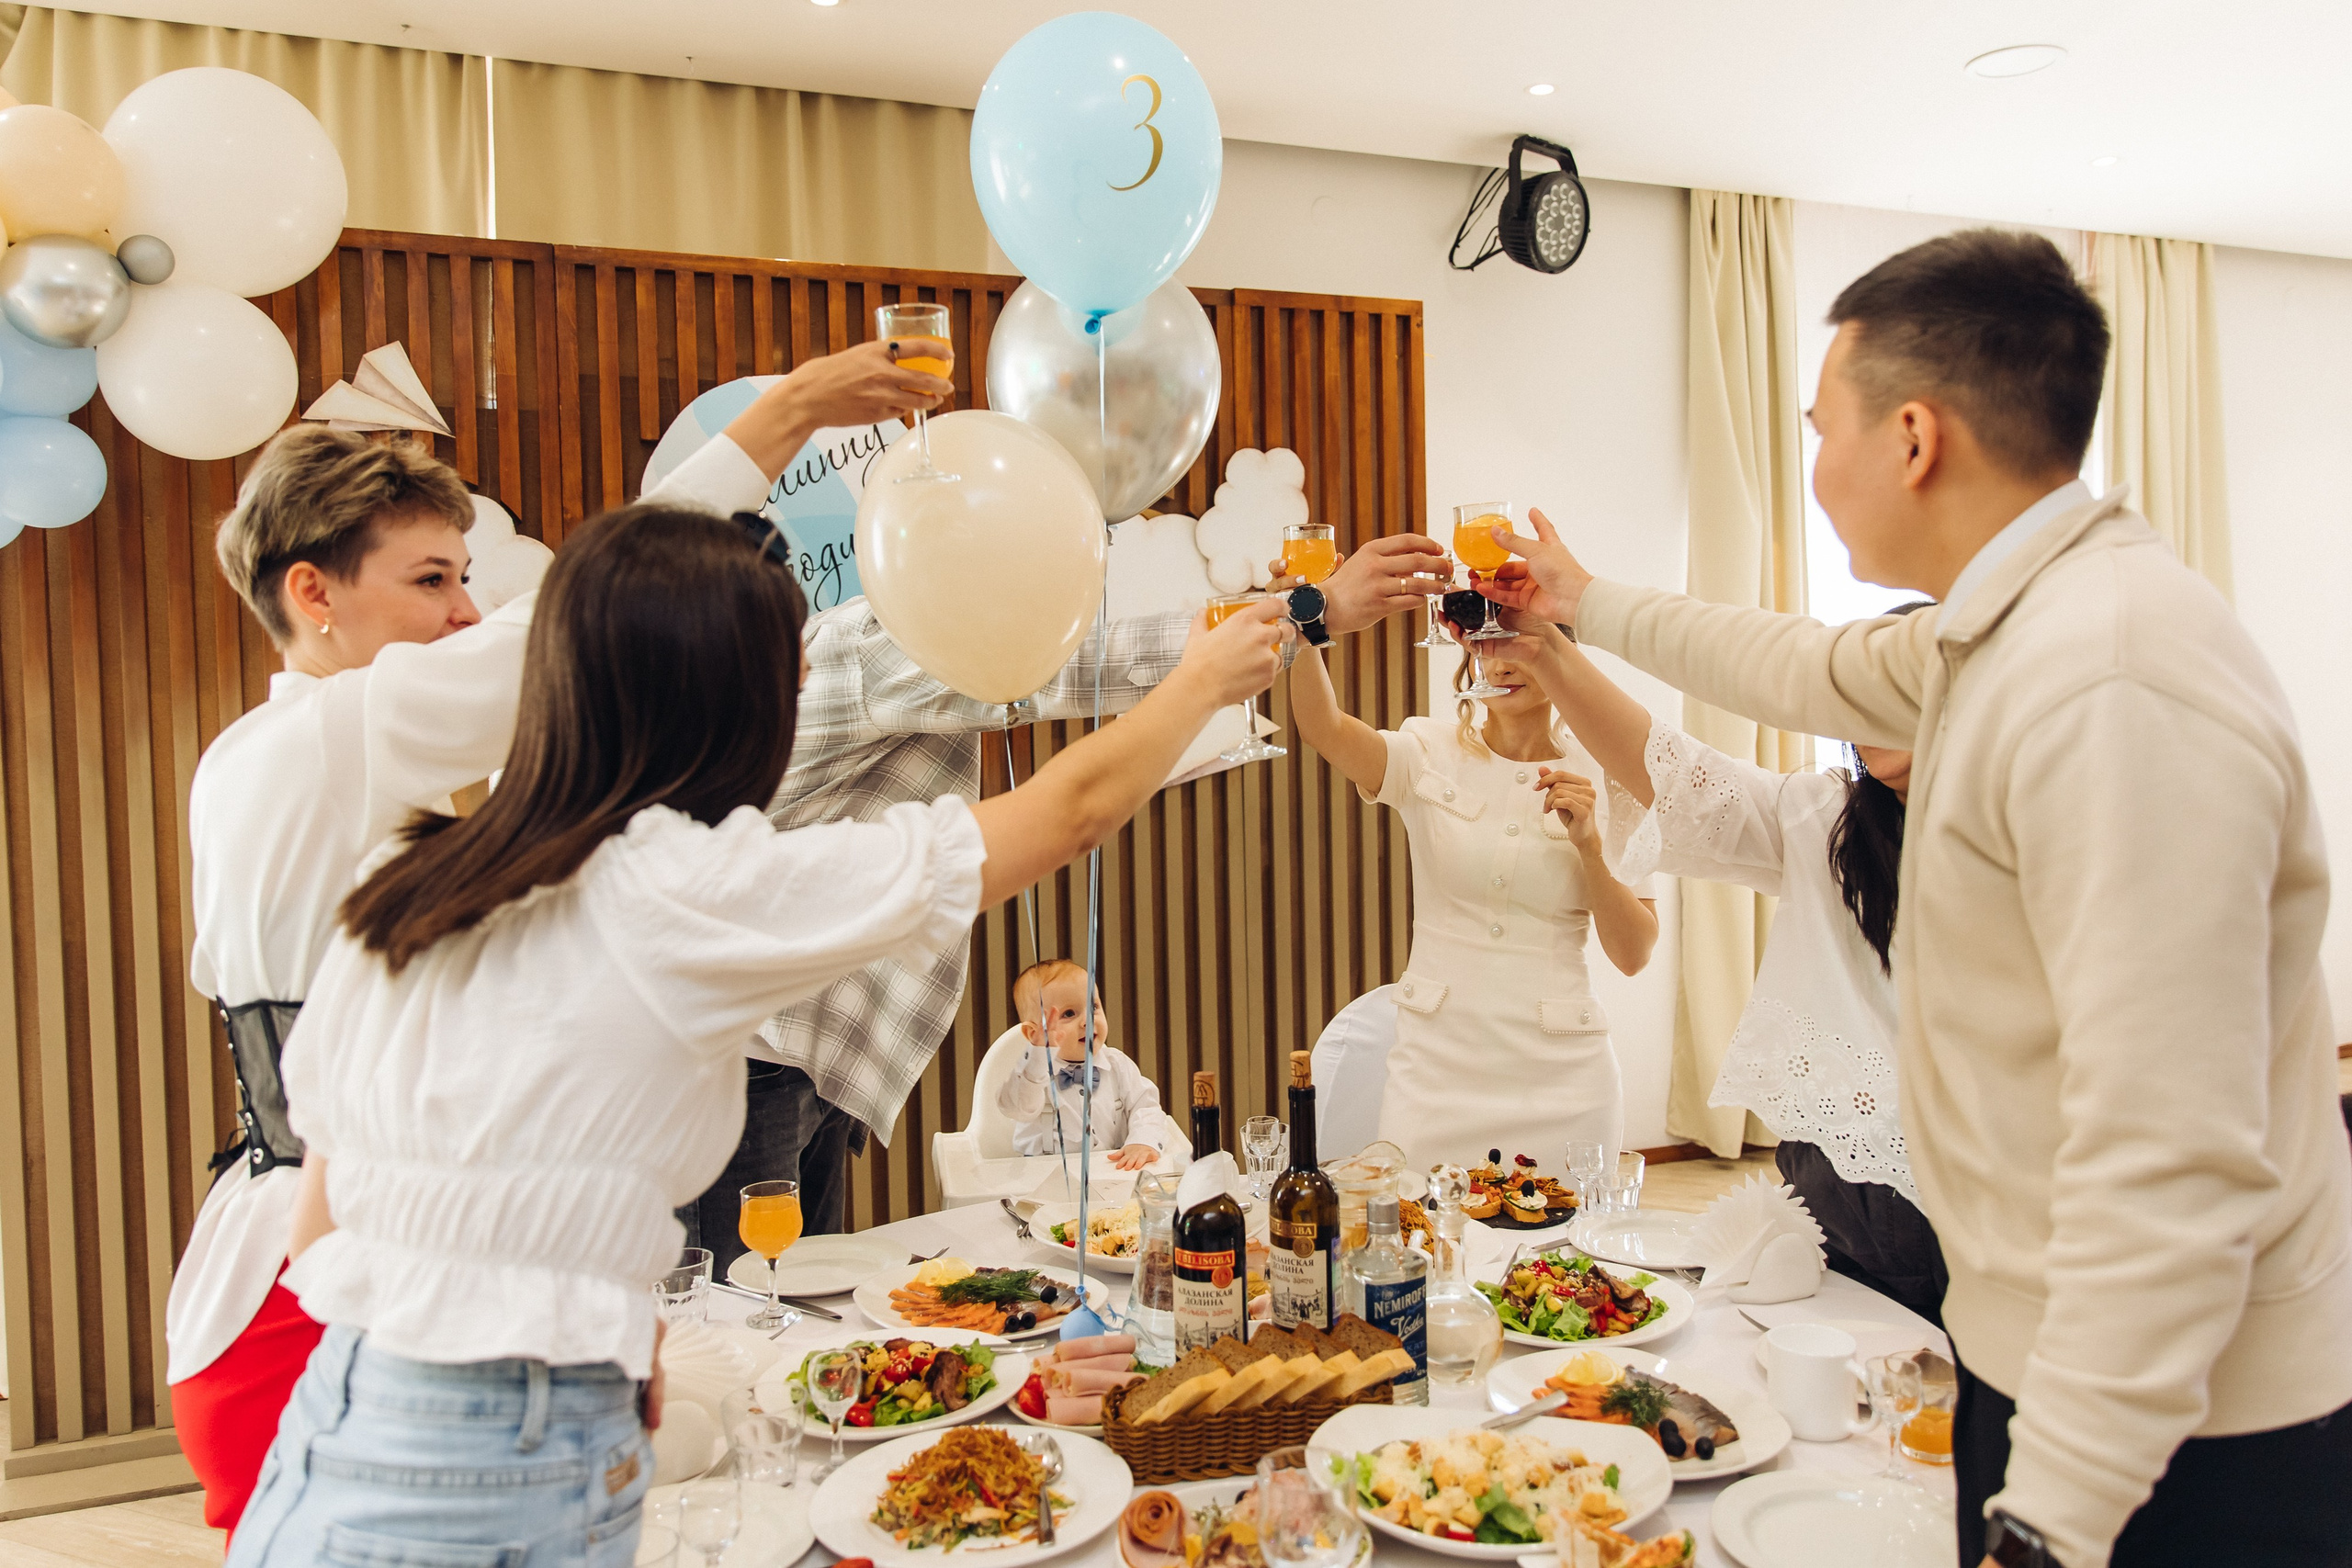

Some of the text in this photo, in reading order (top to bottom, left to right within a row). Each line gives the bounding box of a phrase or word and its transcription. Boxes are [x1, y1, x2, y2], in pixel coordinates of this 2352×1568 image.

[1105, 73, 1163, 191] 3
[1272, 1261, 1304, 1274] ДОЛИНА
[1184, 1297, 1224, 1306] ДОЛИНА
